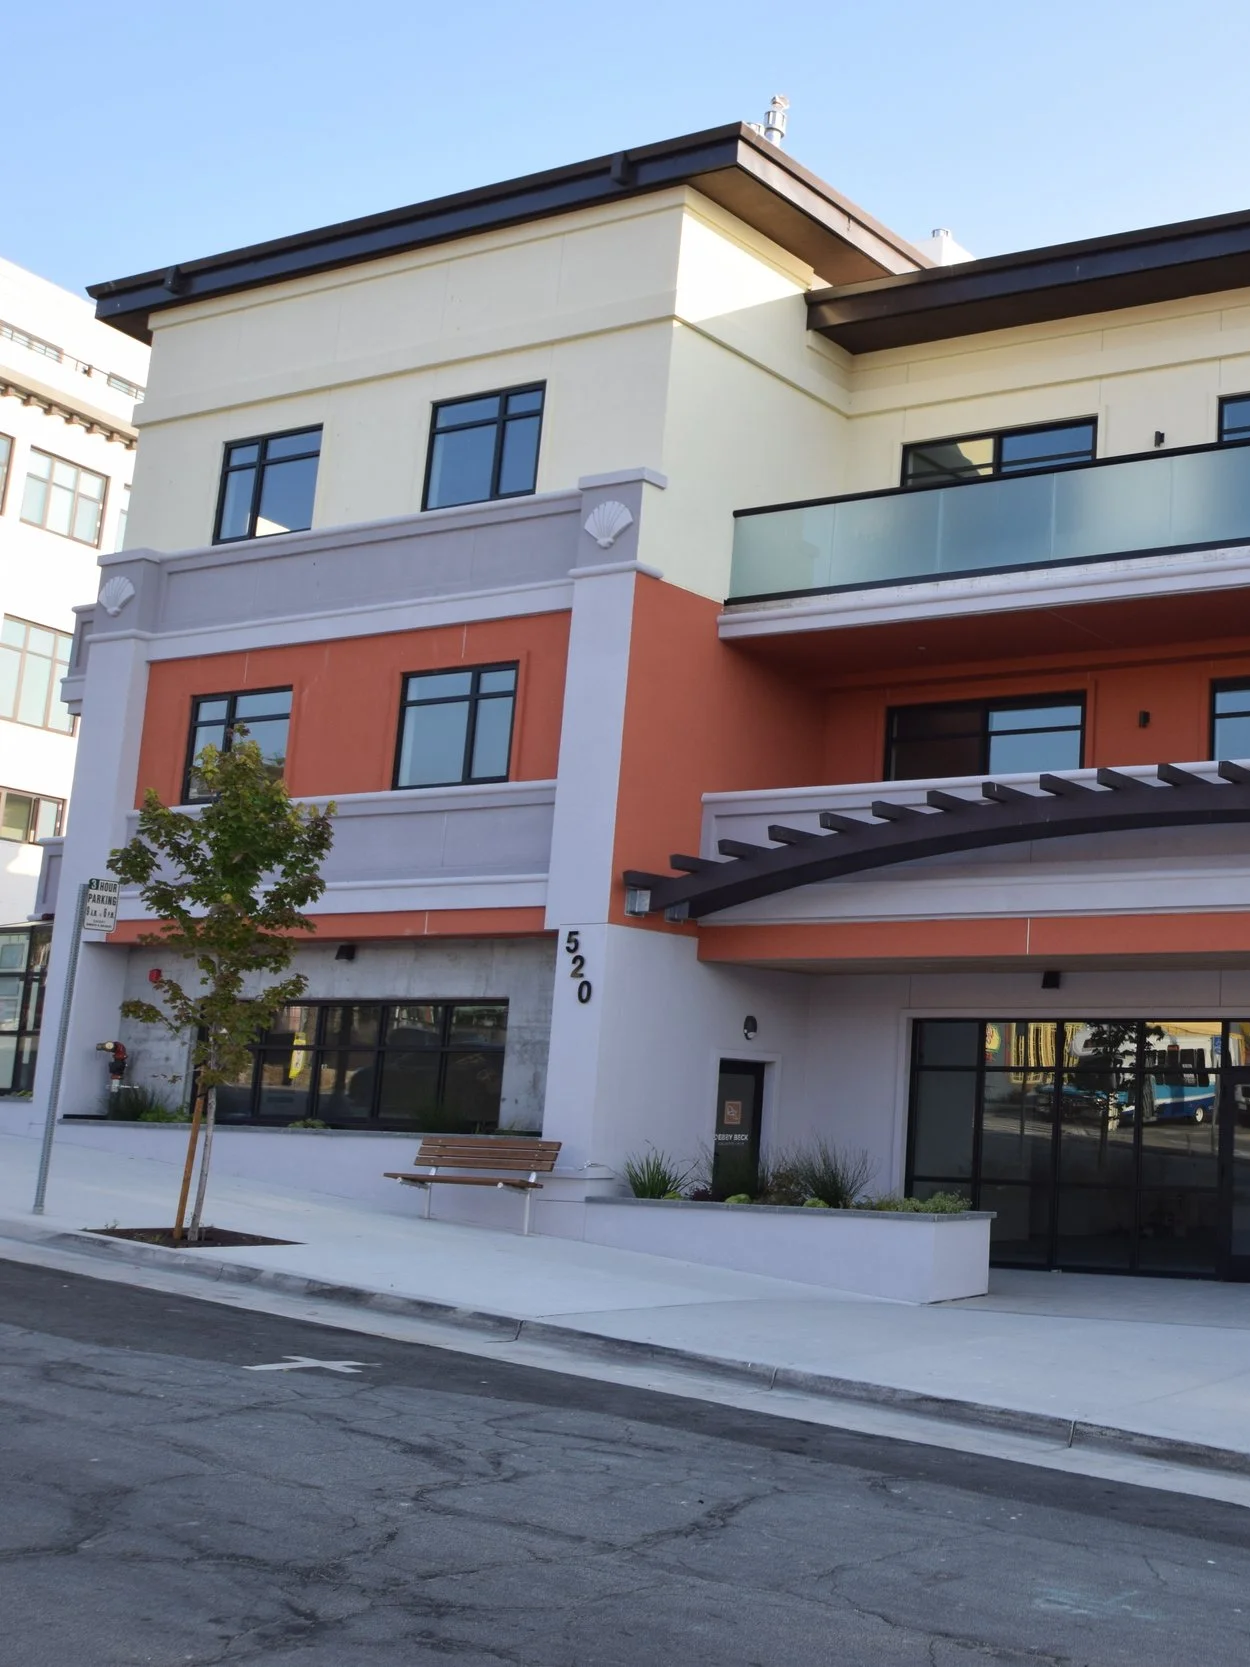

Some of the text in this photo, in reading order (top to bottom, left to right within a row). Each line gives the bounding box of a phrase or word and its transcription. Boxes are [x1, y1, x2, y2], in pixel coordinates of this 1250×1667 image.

[91, 879, 117, 893] 3 HOUR
[88, 893, 117, 906] PARKING
